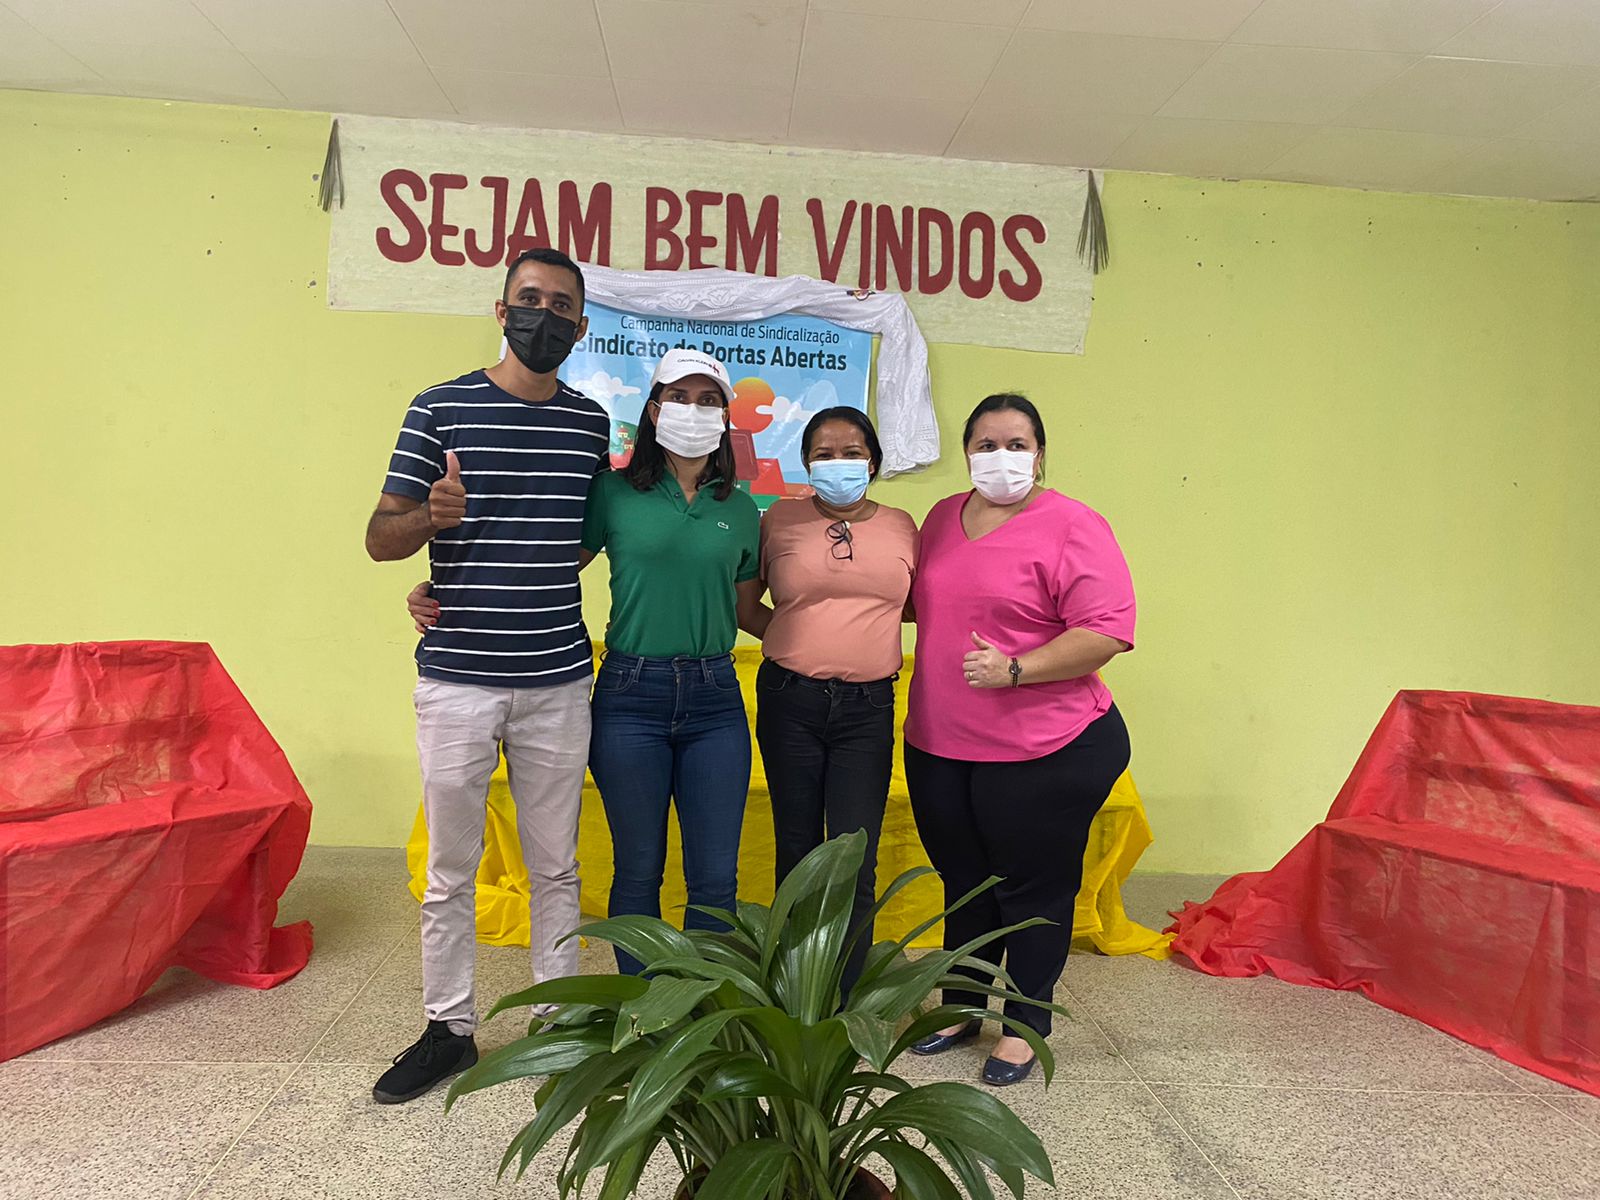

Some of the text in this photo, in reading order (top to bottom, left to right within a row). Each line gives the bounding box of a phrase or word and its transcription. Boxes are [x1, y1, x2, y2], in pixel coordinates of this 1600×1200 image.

[376, 168, 1046, 302] SEJAM BEM VINDOS
[620, 315, 840, 347] Campanha Nacional de Sindicalização
[702, 340, 766, 366] Portas
[770, 345, 848, 371] Abertas
